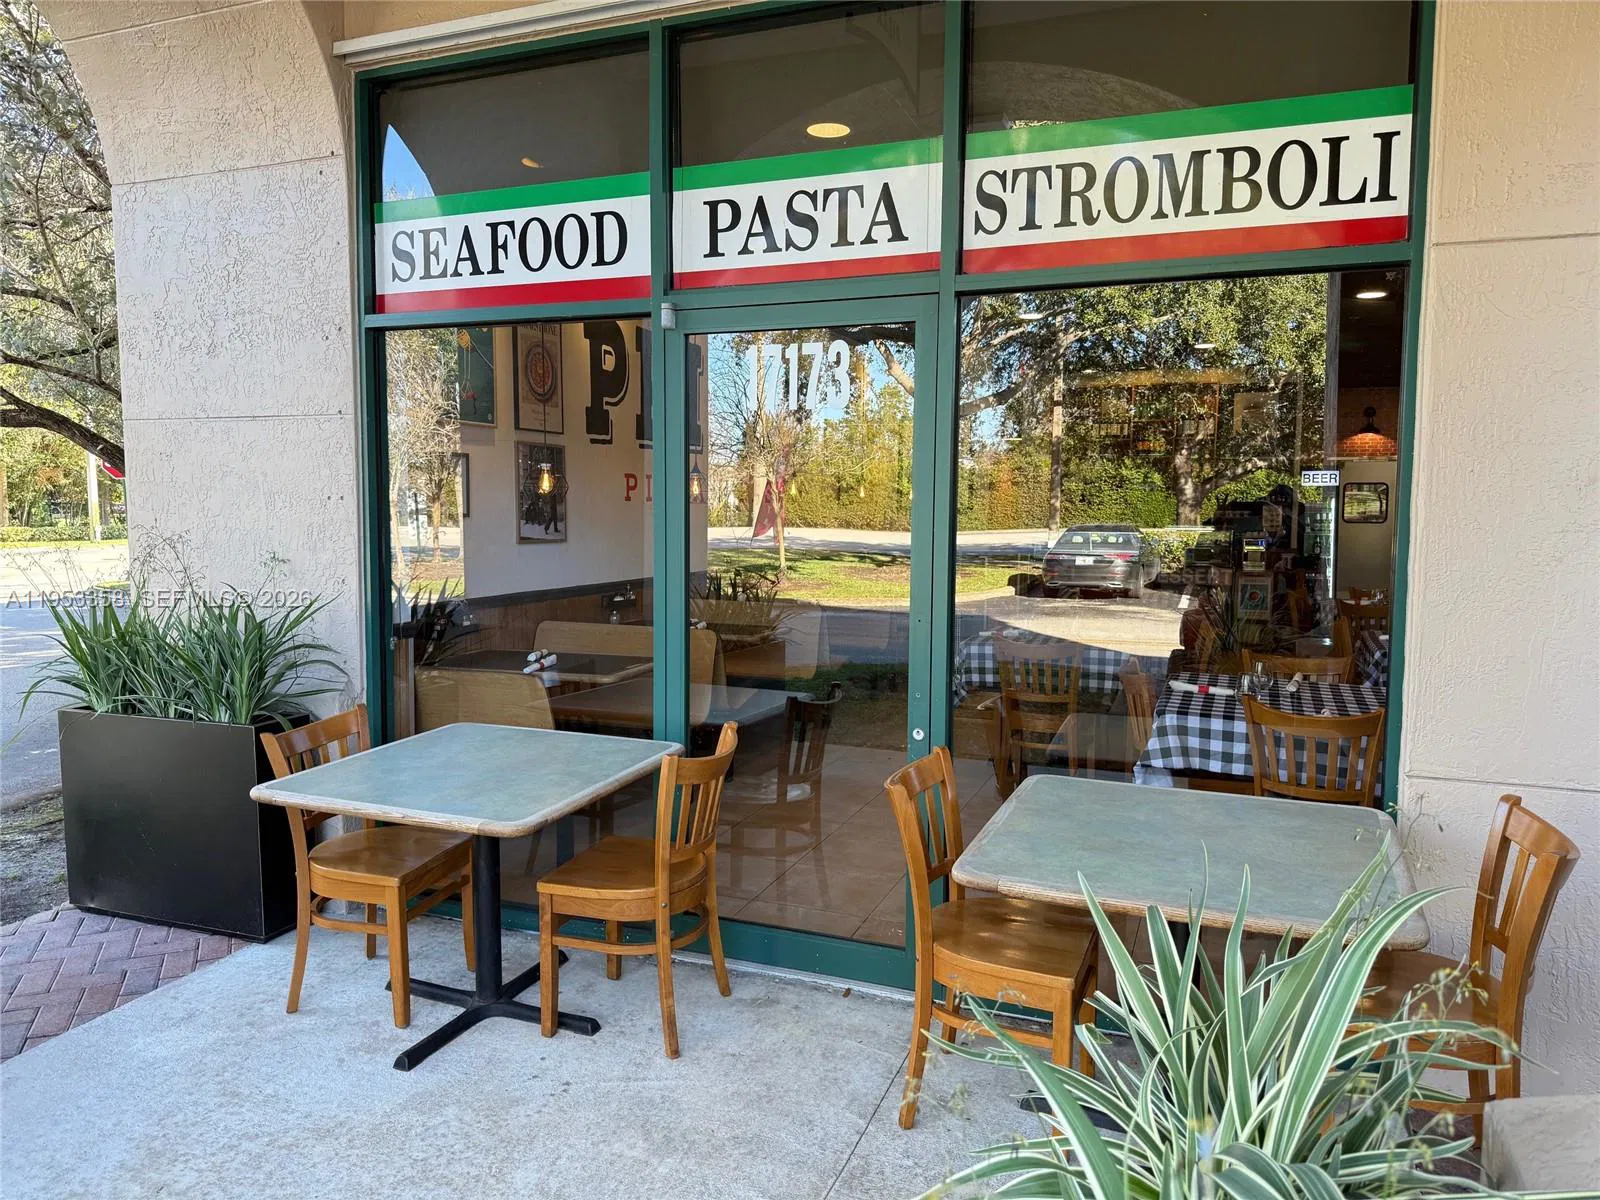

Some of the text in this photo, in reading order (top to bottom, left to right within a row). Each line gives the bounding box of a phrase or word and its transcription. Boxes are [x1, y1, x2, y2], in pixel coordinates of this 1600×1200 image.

[974, 130, 1401, 236] STROMBOLI
[391, 210, 628, 283] SEAFOOD
[703, 182, 909, 259] PASTA
[747, 340, 850, 411] 17173
[1303, 473, 1338, 484] BEER
